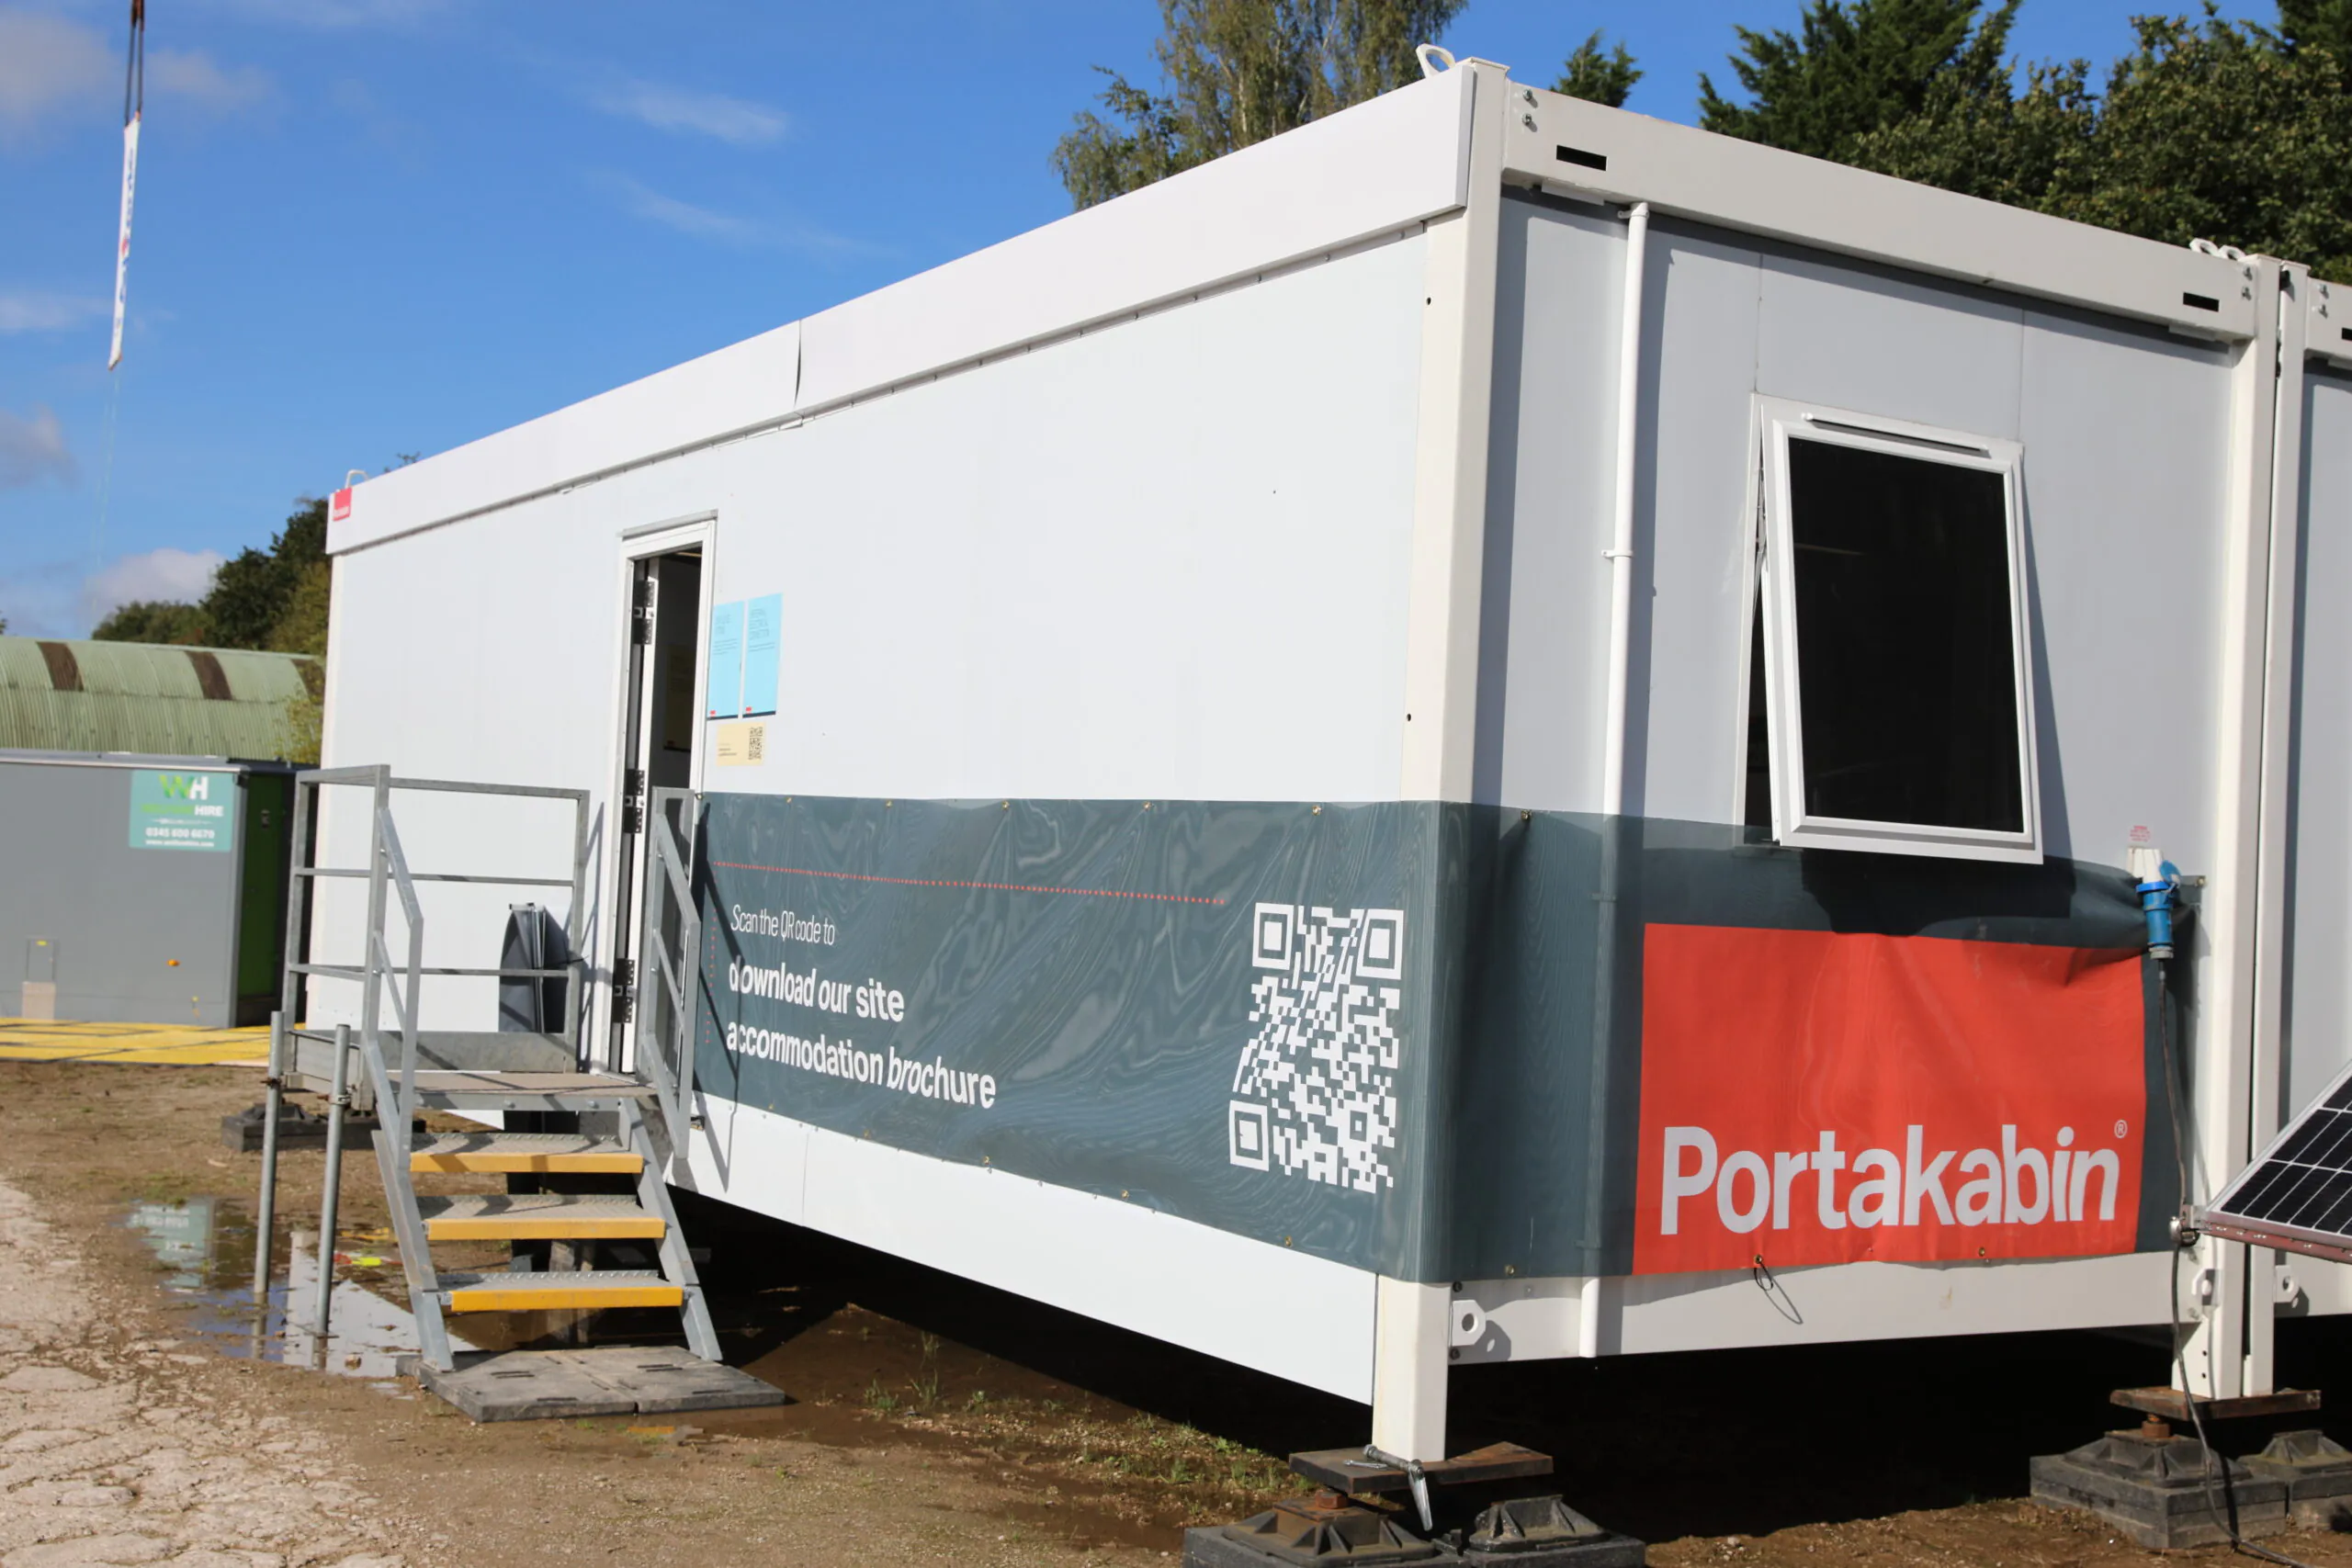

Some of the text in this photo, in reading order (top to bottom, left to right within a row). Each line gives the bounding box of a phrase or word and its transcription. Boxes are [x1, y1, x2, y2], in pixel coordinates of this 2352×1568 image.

[730, 904, 835, 946] Scan the QR code to
[729, 954, 905, 1022] download our site
[726, 1021, 996, 1109] accommodation brochure
